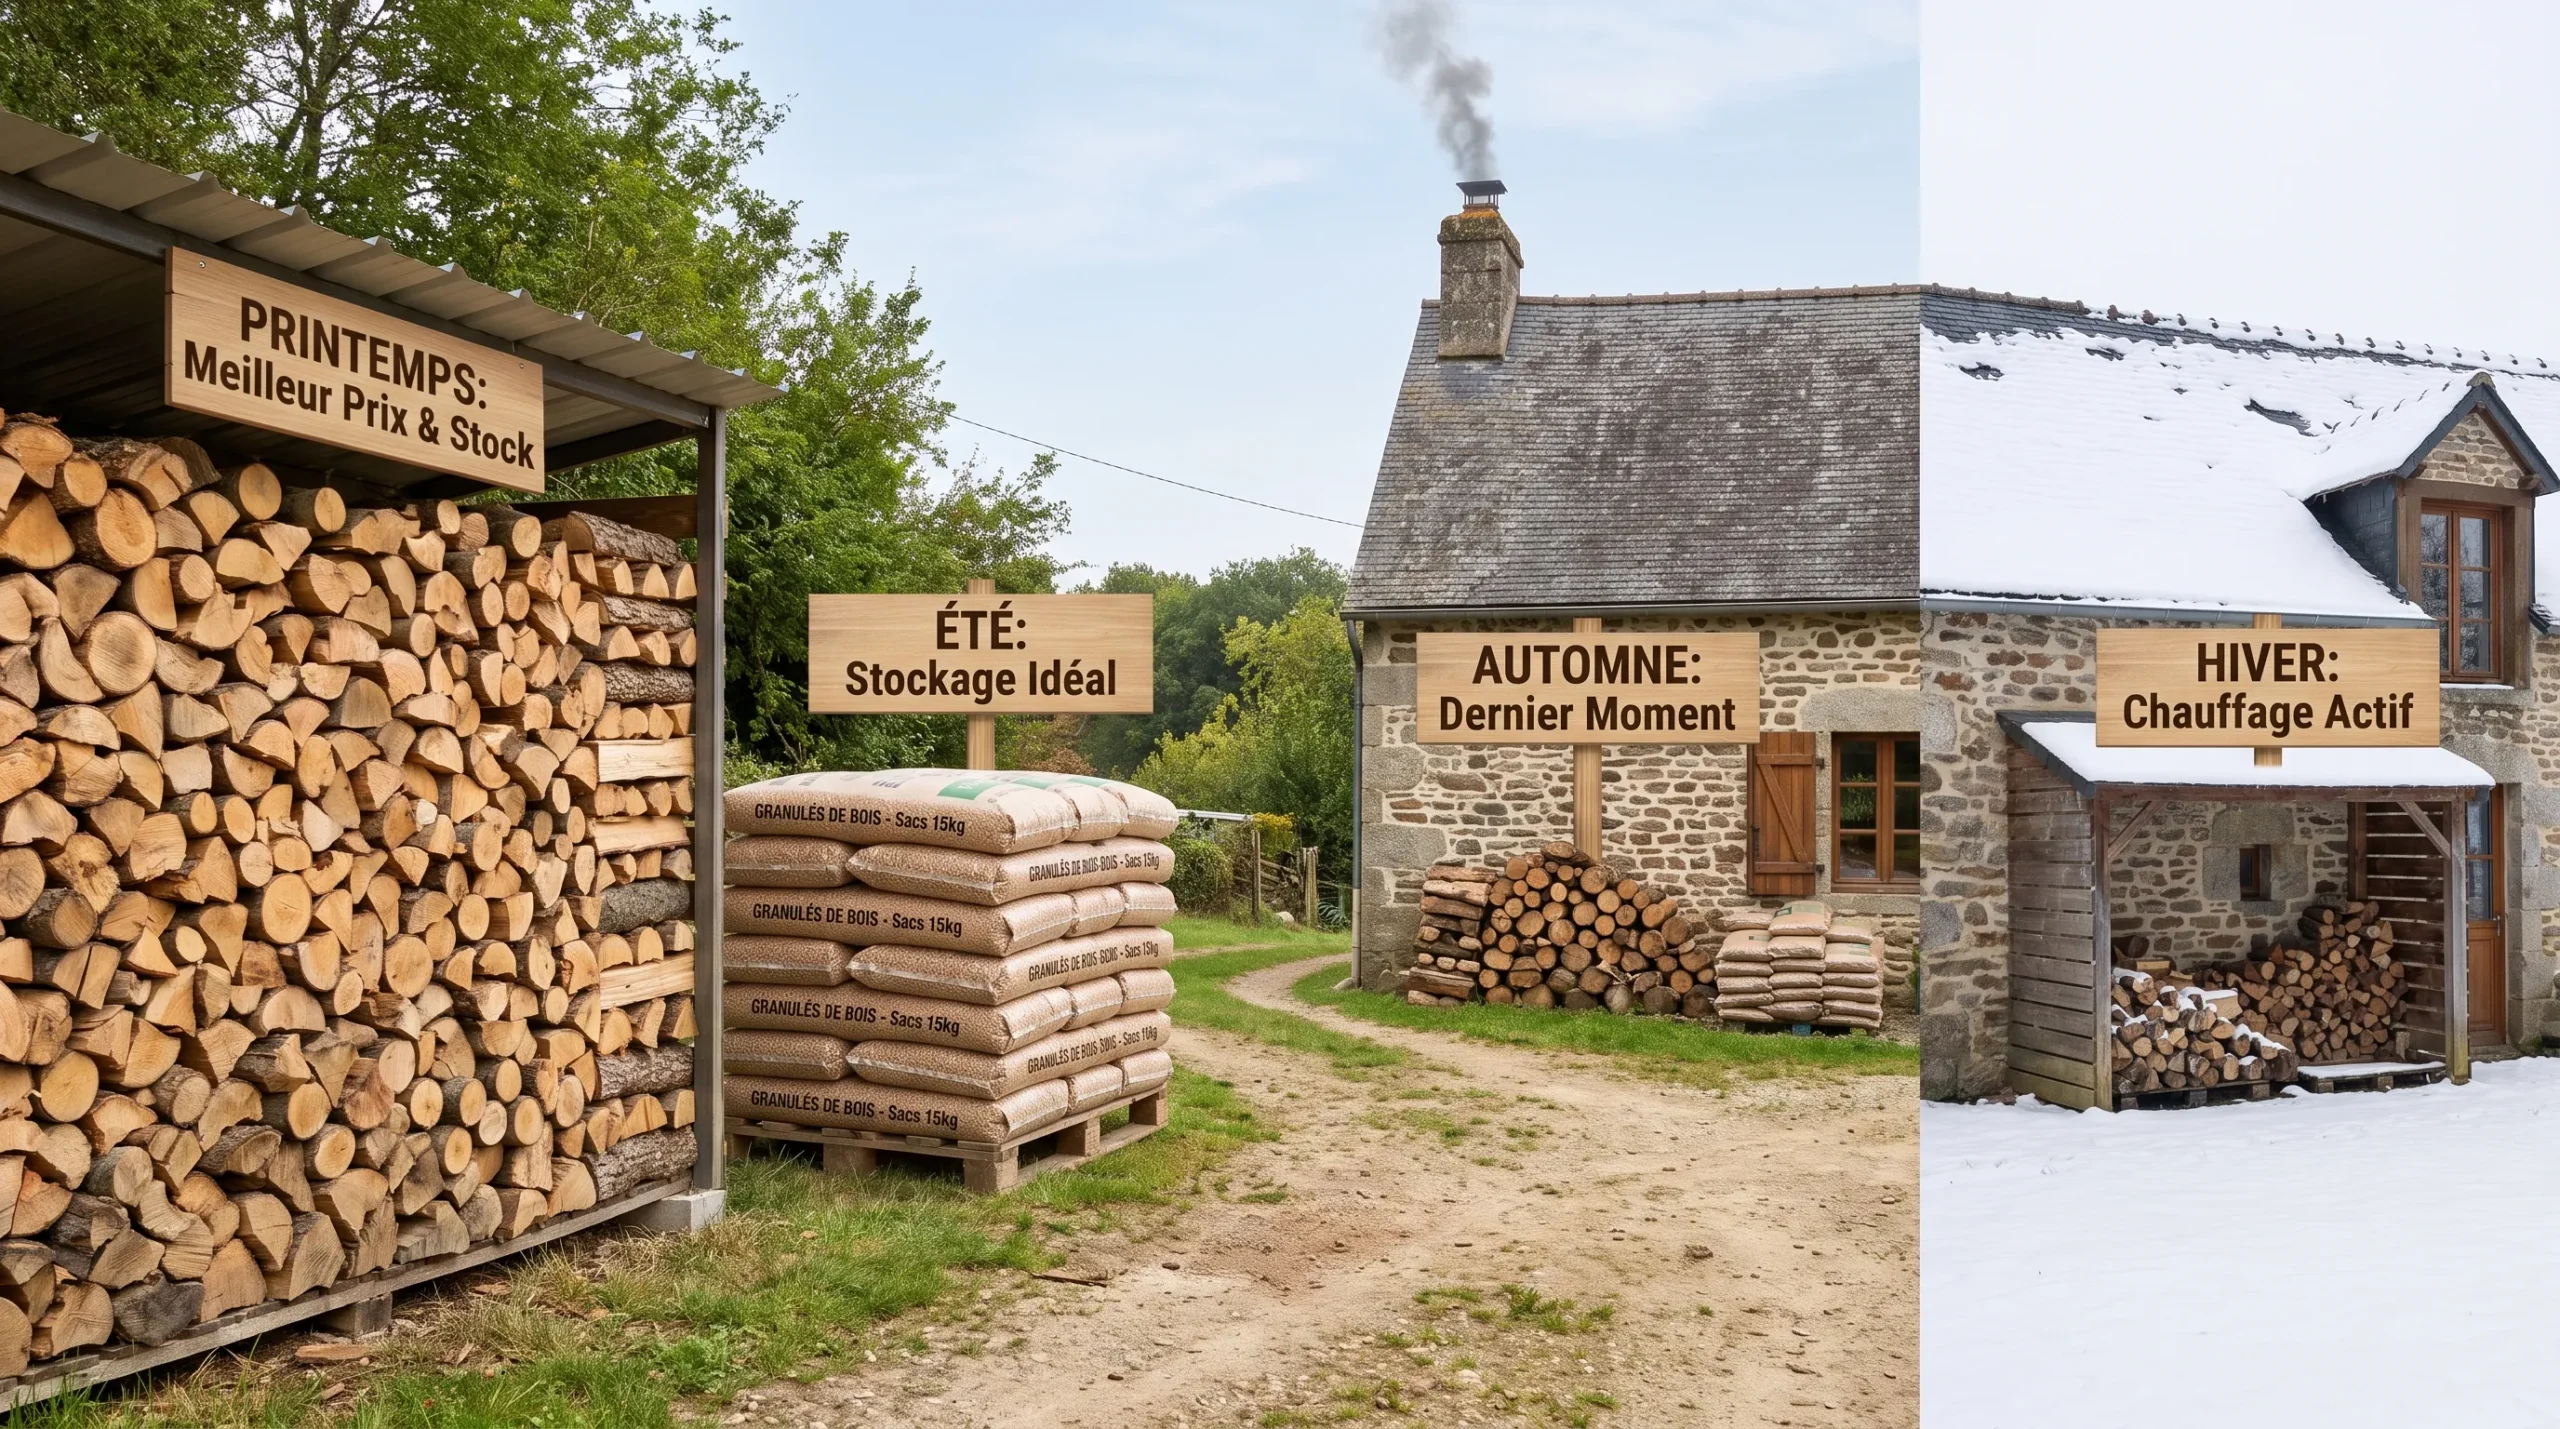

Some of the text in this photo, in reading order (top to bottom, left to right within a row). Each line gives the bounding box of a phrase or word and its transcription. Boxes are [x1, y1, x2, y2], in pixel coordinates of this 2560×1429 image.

[241, 296, 487, 410] PRINTEMPS:
[184, 339, 534, 470] Meilleur Prix & Stock
[936, 600, 1026, 650] ÉTÉ:
[846, 659, 1116, 705] Stockage Idéal
[1472, 644, 1701, 685] AUTOMNE:
[2197, 643, 2338, 682] HIVER:
[1440, 694, 1736, 731] Dernier Moment
[2123, 692, 2414, 738] Chauffage Actif
[829, 807, 846, 823] DE
[850, 808, 881, 825] BOIS
[895, 811, 927, 830] Sacs
[932, 815, 965, 836] 15kg
[1124, 853, 1142, 868] Sacs
[753, 903, 822, 922] GRANULÉS
[826, 908, 843, 924] DE
[847, 909, 879, 926] BOIS
[892, 913, 924, 930] Sacs
[929, 916, 962, 938] 15kg
[1124, 944, 1141, 959] Sacs
[751, 999, 820, 1018] GRANULÉS
[824, 1004, 841, 1020] DE
[845, 1006, 877, 1023] BOIS
[890, 1010, 922, 1029] Sacs
[927, 1015, 960, 1037] 15kg
[1071, 1045, 1080, 1062] DE
[1123, 1030, 1140, 1046] Sacs
[751, 1090, 818, 1111] GRANULÉS
[823, 1097, 840, 1114] DE
[843, 1099, 875, 1118] BOIS
[888, 1104, 920, 1123] Sacs
[925, 1109, 958, 1131] 15kg
